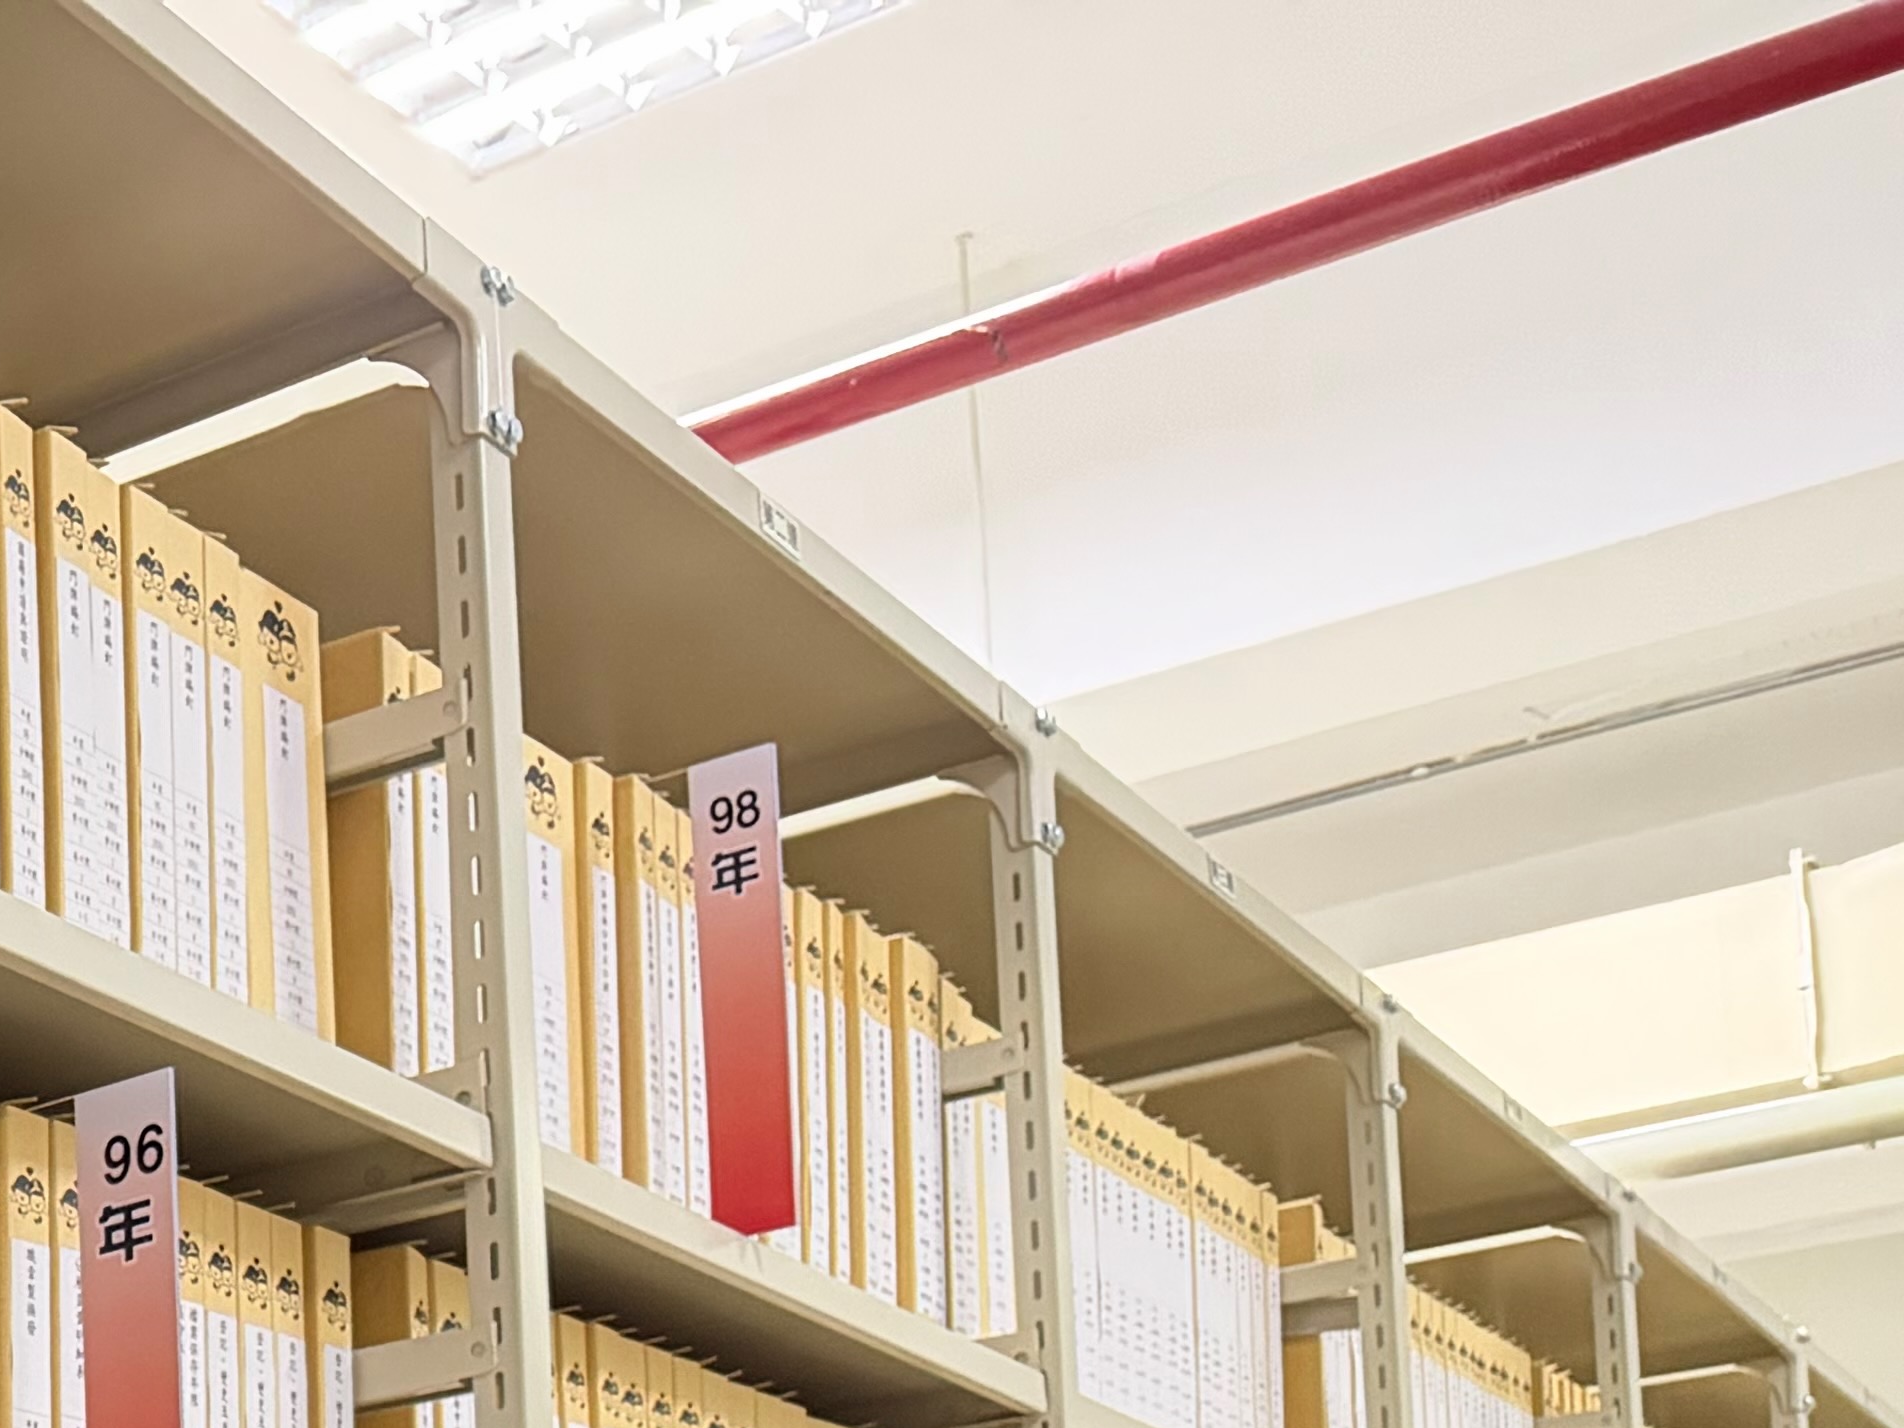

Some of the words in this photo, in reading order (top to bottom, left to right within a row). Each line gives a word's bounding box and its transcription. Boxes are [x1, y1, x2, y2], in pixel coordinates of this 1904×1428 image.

[709, 789, 760, 833] 98
[712, 847, 760, 894] 年
[103, 1125, 165, 1185] 96
[99, 1203, 153, 1263] 年
